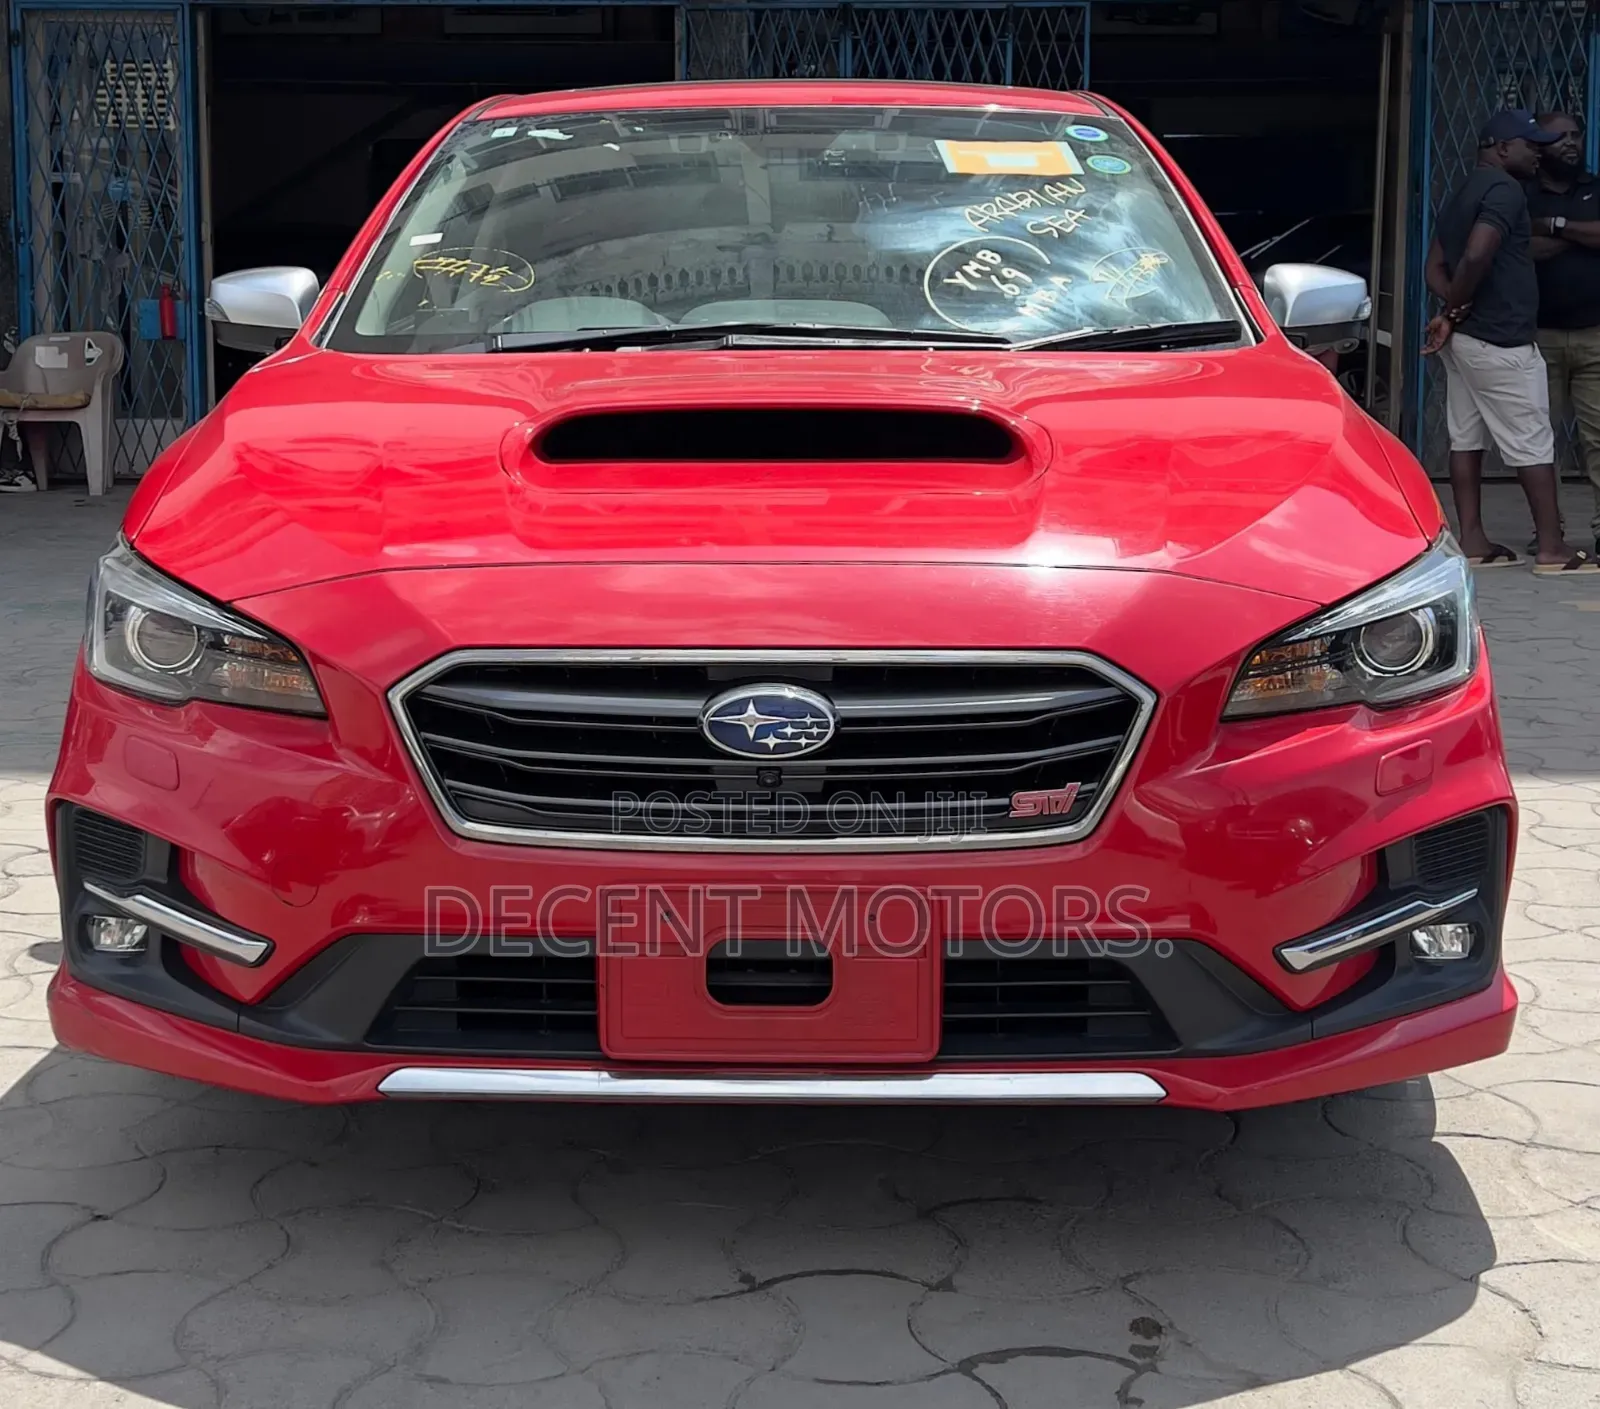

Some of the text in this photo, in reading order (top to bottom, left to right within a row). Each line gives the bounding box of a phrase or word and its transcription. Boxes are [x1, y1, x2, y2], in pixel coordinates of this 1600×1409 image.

[965, 178, 1086, 232] ARABIAN
[1026, 209, 1092, 238] SEA
[943, 249, 1002, 291] YMB
[990, 267, 1033, 296] 69
